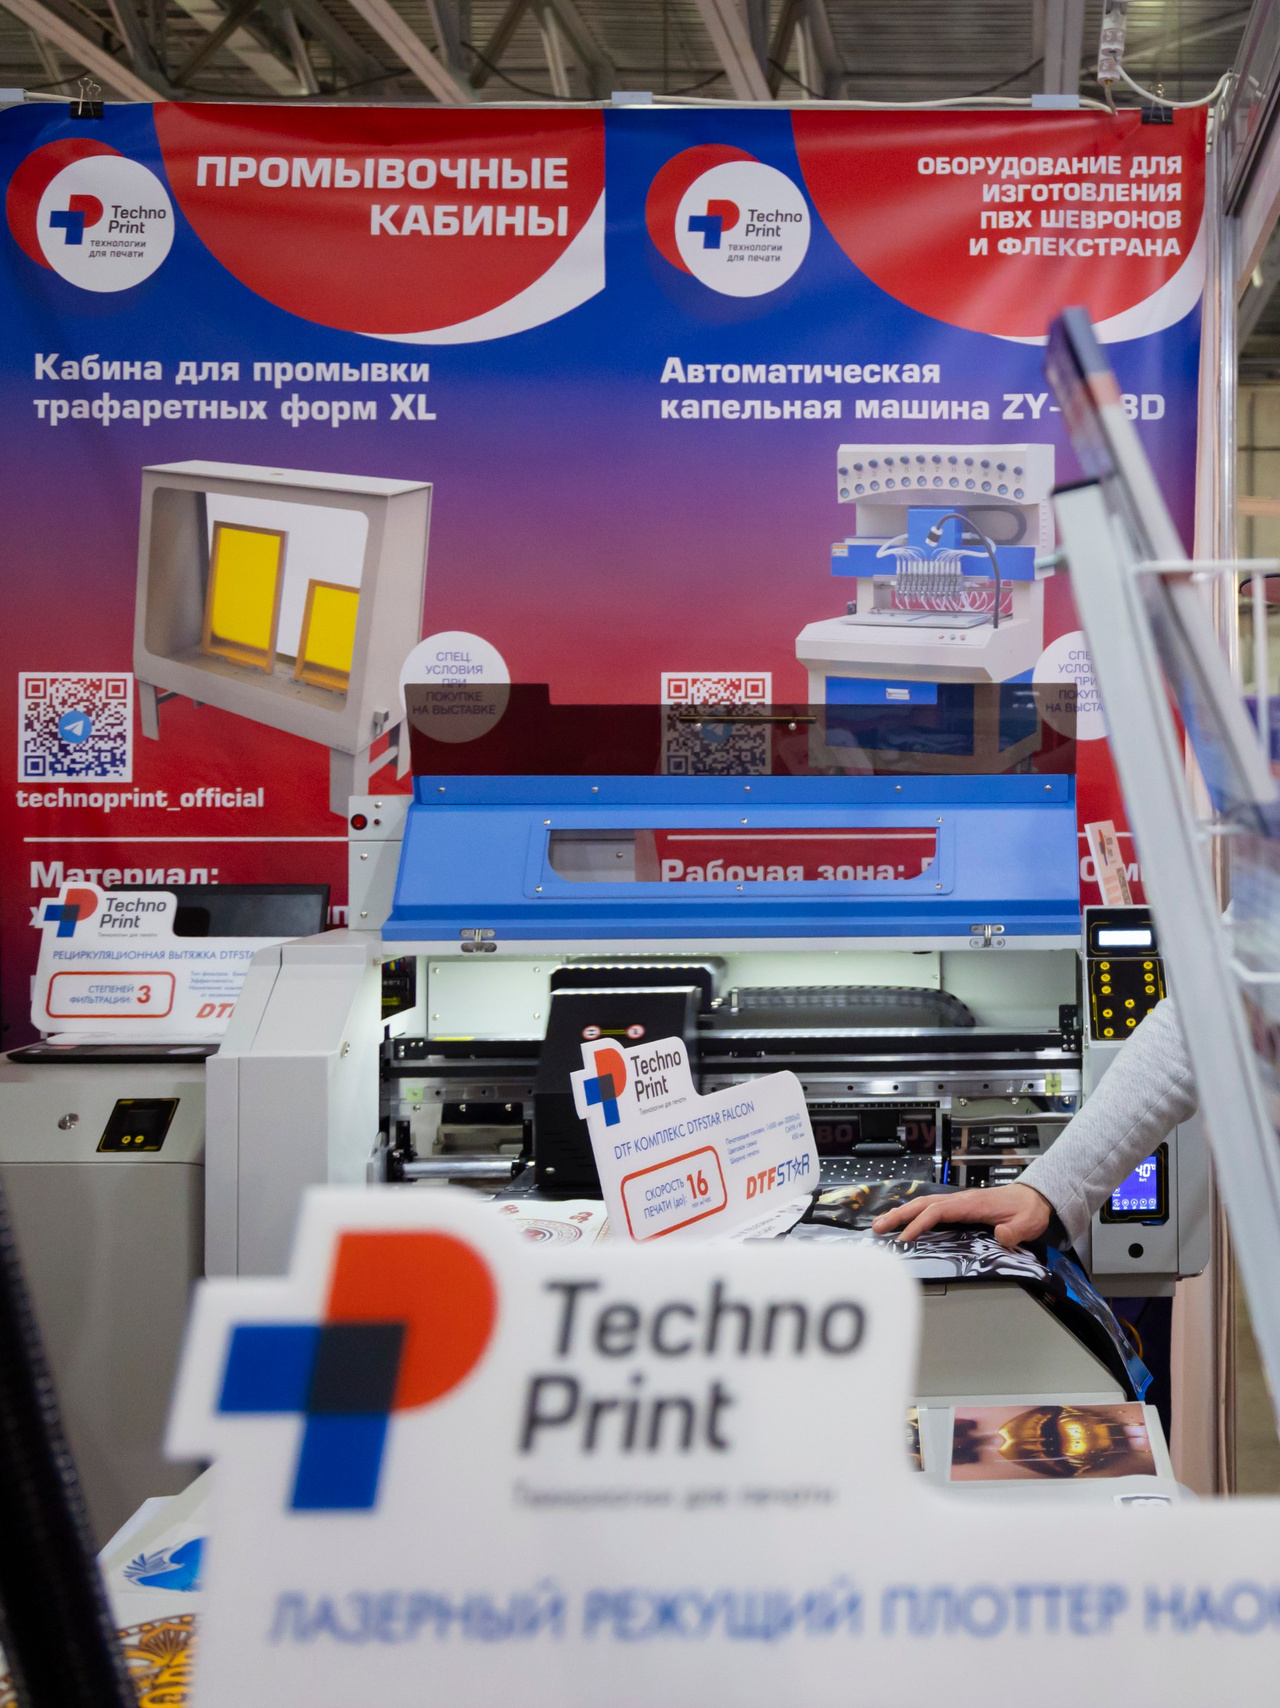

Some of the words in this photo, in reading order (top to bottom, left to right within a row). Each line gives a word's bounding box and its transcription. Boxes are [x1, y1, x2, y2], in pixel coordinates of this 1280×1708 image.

[197, 155, 569, 190] ПРОМЫВОЧНЫЕ
[917, 155, 1122, 177] ОБОРУДОВАНИЕ
[1130, 155, 1183, 177] ДЛЯ
[982, 182, 1182, 203] ИЗГОТОВЛЕНИЯ
[111, 205, 167, 219] Techno
[370, 204, 569, 237] КАБИНЫ
[748, 209, 803, 223] Techno
[981, 209, 1032, 230] ПВХ
[1040, 209, 1182, 230] ШЕВРОНОВ
[108, 220, 145, 234] Print
[745, 224, 781, 237] Print
[90, 239, 146, 247] технологии
[728, 243, 783, 251] технологии
[969, 238, 990, 256] И
[997, 237, 1181, 257] ФЛЕКСТРАНА
[88, 250, 106, 258] для
[110, 250, 144, 258] печати
[727, 254, 744, 262] для
[748, 254, 781, 262] печати
[34, 353, 163, 381] Кабина
[175, 360, 240, 386] для
[253, 362, 430, 386] промывки
[660, 356, 941, 384] Автоматическая
[34, 394, 268, 427] трафаретных
[280, 395, 377, 428] форм
[390, 394, 437, 421] XL
[660, 399, 842, 422] капельная
[855, 399, 990, 422] машина
[436, 652, 472, 663] СПЕЦ.
[425, 665, 483, 675] УСЛОВИЯ
[442, 678, 467, 688] ПРИ
[426, 692, 483, 701] ПОКУПКЕ
[412, 705, 429, 715] НА
[432, 704, 496, 715] ВЫСТАВКЕ
[1045, 703, 1062, 712] НА
[16, 787, 264, 813] technoprint_official
[30, 861, 219, 888] Материал:
[661, 858, 805, 882] Рабочая
[817, 864, 905, 881] зона:
[105, 897, 167, 912] Techno
[99, 913, 141, 928] Print
[53, 950, 166, 961] РЕЦИРКУЛЯЦИОННАЯ
[168, 950, 216, 960] ВЫТЯЖКА
[88, 984, 134, 993] СТЕПЕНЕЙ
[136, 985, 151, 1004] 3
[631, 1050, 682, 1077] Techno
[634, 1075, 669, 1102] Print
[614, 1143, 632, 1159] DTF
[634, 1124, 686, 1152] КОМПЛЕКС
[687, 1114, 722, 1135] DTFSTAR
[722, 1101, 755, 1122] FALCON
[645, 1175, 685, 1201] СКОРОСТЬ
[686, 1169, 709, 1199] 16
[644, 1201, 672, 1219] ПЕЧАТИ
[545, 1281, 867, 1358] Techno
[518, 1373, 735, 1455] Print
[269, 1576, 567, 1643] ЛАЗЕРНЫЙ
[582, 1574, 864, 1644] РЕЖУЩИЙ
[880, 1583, 1132, 1638] ПЛОТТЕР
